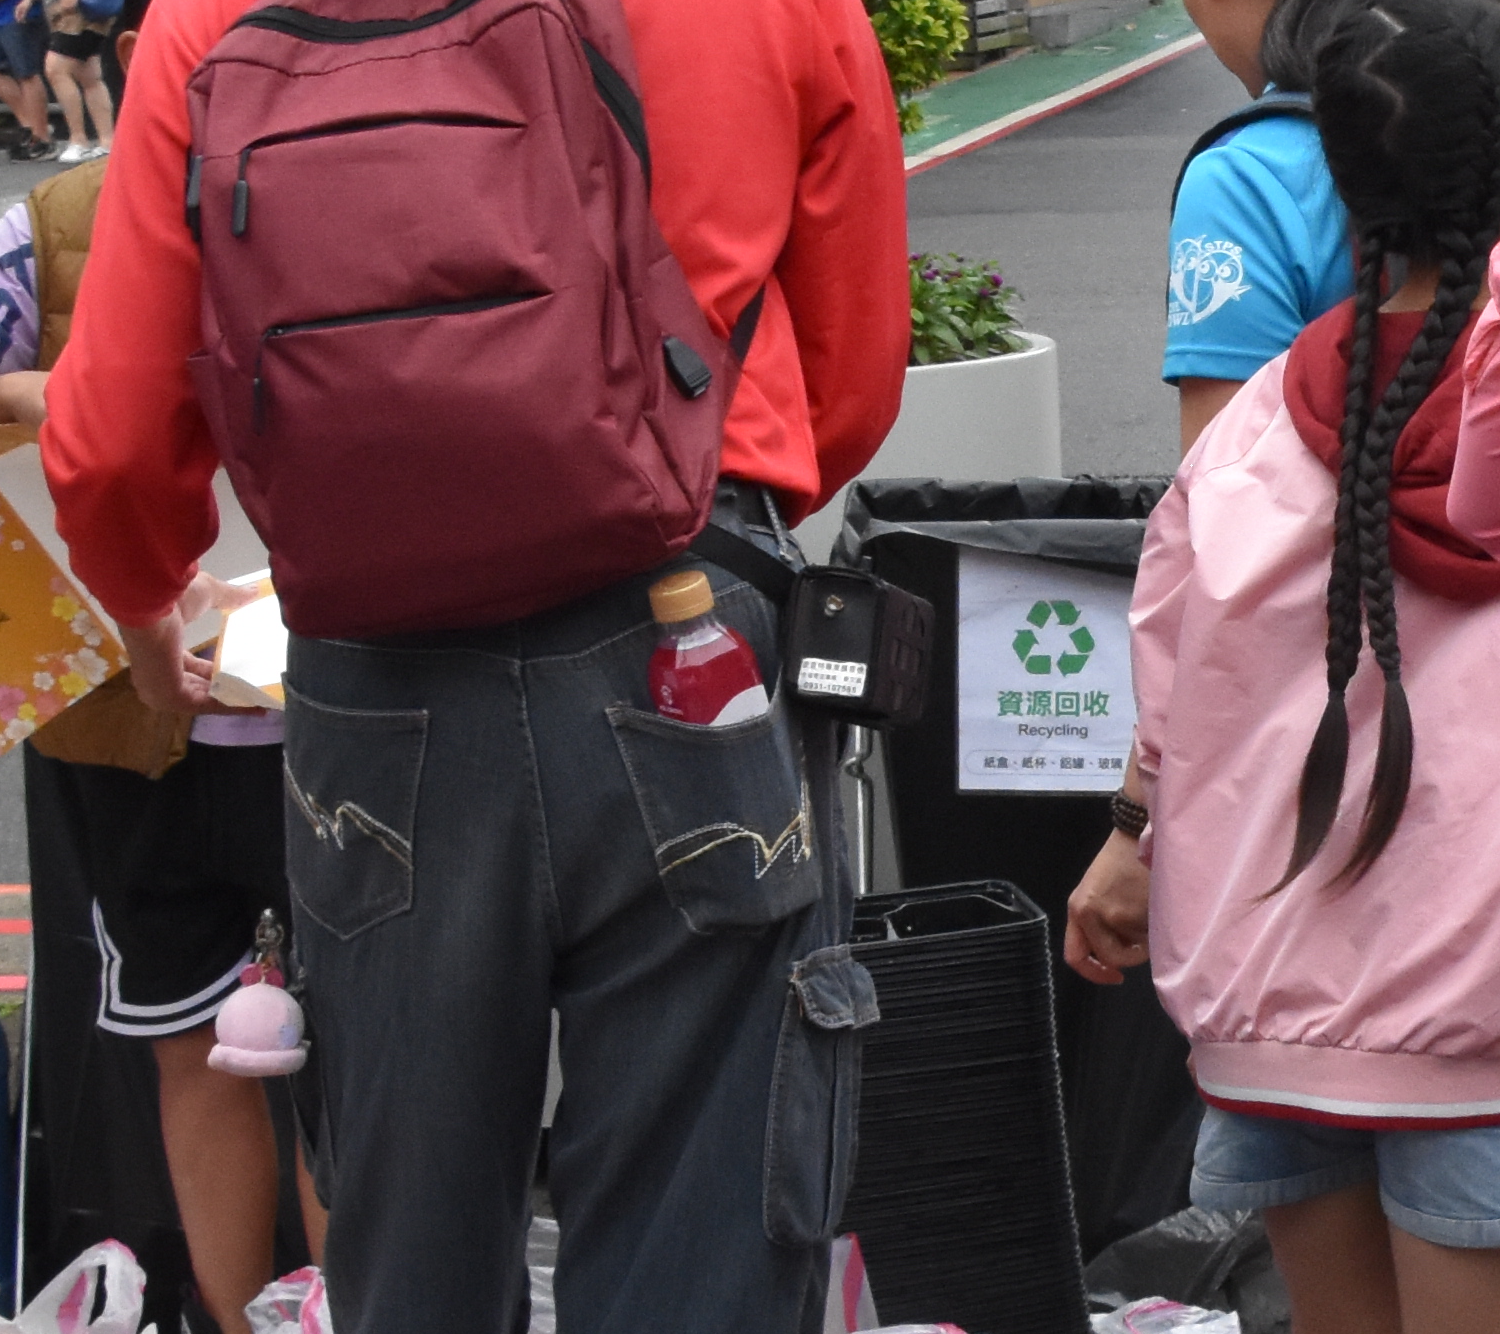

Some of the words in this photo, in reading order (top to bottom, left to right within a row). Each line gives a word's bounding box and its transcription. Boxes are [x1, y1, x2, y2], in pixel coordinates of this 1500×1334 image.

[997, 690, 1111, 717] 資源回收
[1018, 723, 1089, 739] Recycling
